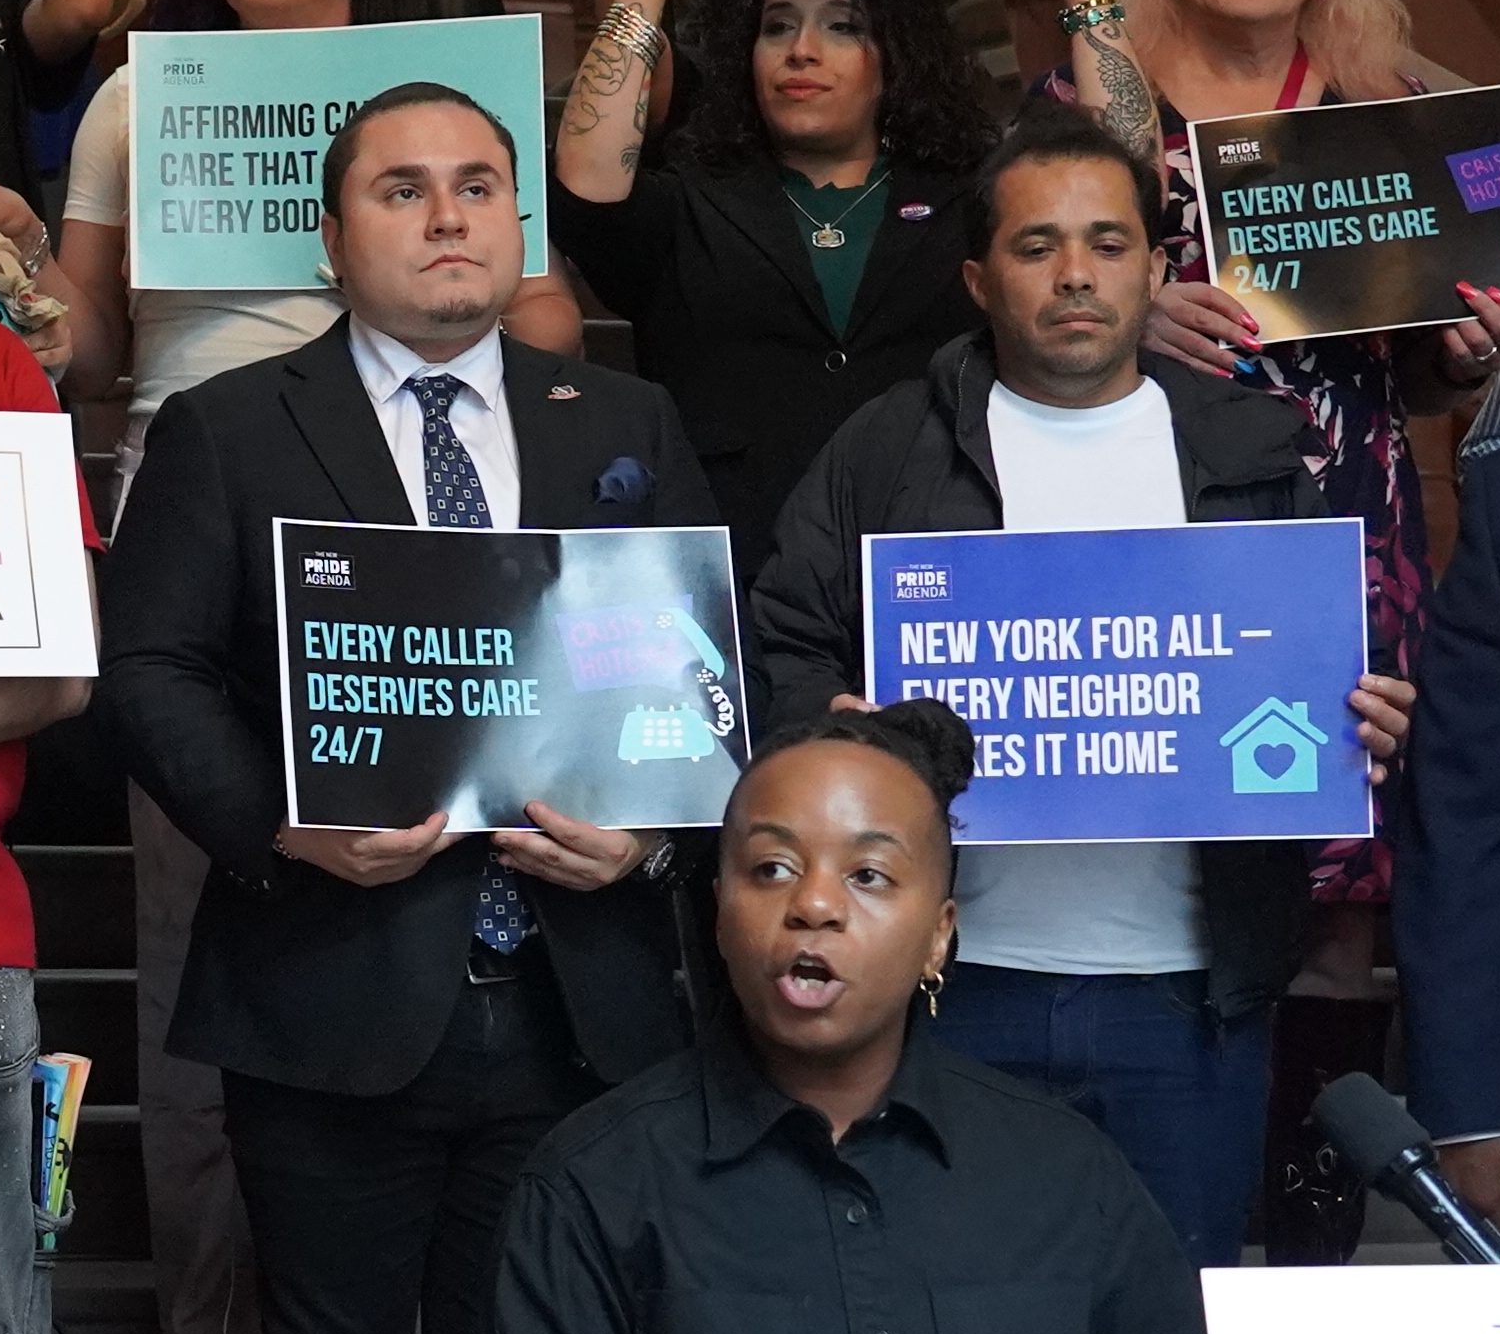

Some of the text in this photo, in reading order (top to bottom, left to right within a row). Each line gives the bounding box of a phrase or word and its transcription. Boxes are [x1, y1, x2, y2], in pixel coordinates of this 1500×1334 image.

[163, 63, 205, 75] PRIDE
[163, 75, 205, 85] AGENDA
[159, 100, 369, 140] AFFIRMING CA
[1218, 141, 1260, 156] PRIDE
[1219, 153, 1261, 166] AGENDA
[161, 150, 318, 186] CARE THAT
[1222, 172, 1413, 220] EVERY CALLER
[162, 198, 326, 233] EVERY BOD
[1228, 207, 1440, 256] DESERVES CARE
[1234, 261, 1300, 295] 24/7
[304, 558, 350, 575] PRIDE
[305, 573, 351, 587] AGENDA
[896, 570, 947, 587] PRIDE
[896, 585, 948, 600] AGENDA
[304, 621, 515, 666] EVERY CALLER
[900, 613, 1233, 665] NEW YORK FOR ALL
[306, 672, 541, 717] DESERVES CARE
[1023, 672, 1200, 719] NEIGHBOR
[310, 724, 383, 766] 24/7
[1036, 731, 1179, 776] IT HOME
